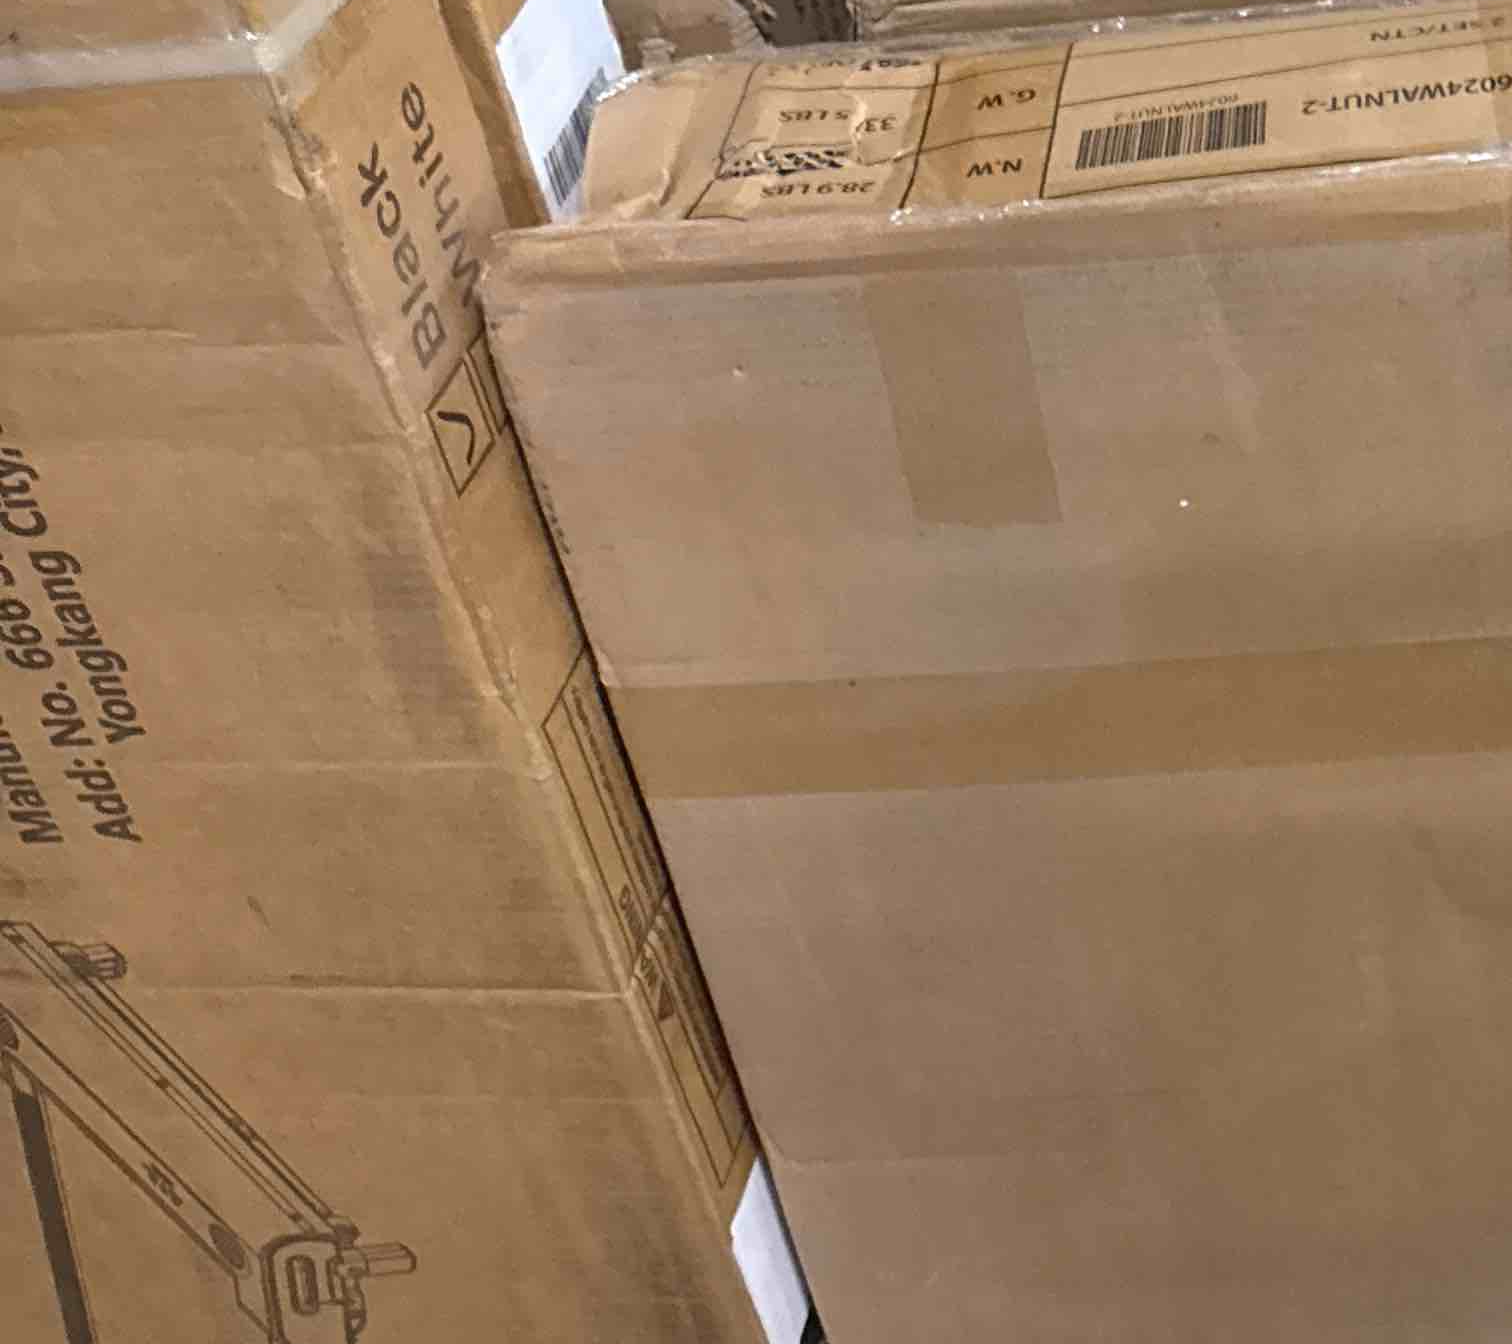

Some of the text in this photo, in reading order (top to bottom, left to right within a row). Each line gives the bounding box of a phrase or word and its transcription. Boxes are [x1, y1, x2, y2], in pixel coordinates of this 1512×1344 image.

[777, 109, 830, 124] LBS
[975, 87, 1038, 110] G.W
[1112, 92, 1241, 124] 6024WALNUT-2
[759, 181, 875, 199] 28.9 LBS
[965, 156, 1025, 179] N.W
[401, 80, 483, 310] White
[358, 140, 448, 371] Black
[28, 549, 147, 746] Yongkang
[40, 680, 96, 748] No.
[64, 758, 144, 844] Add:
